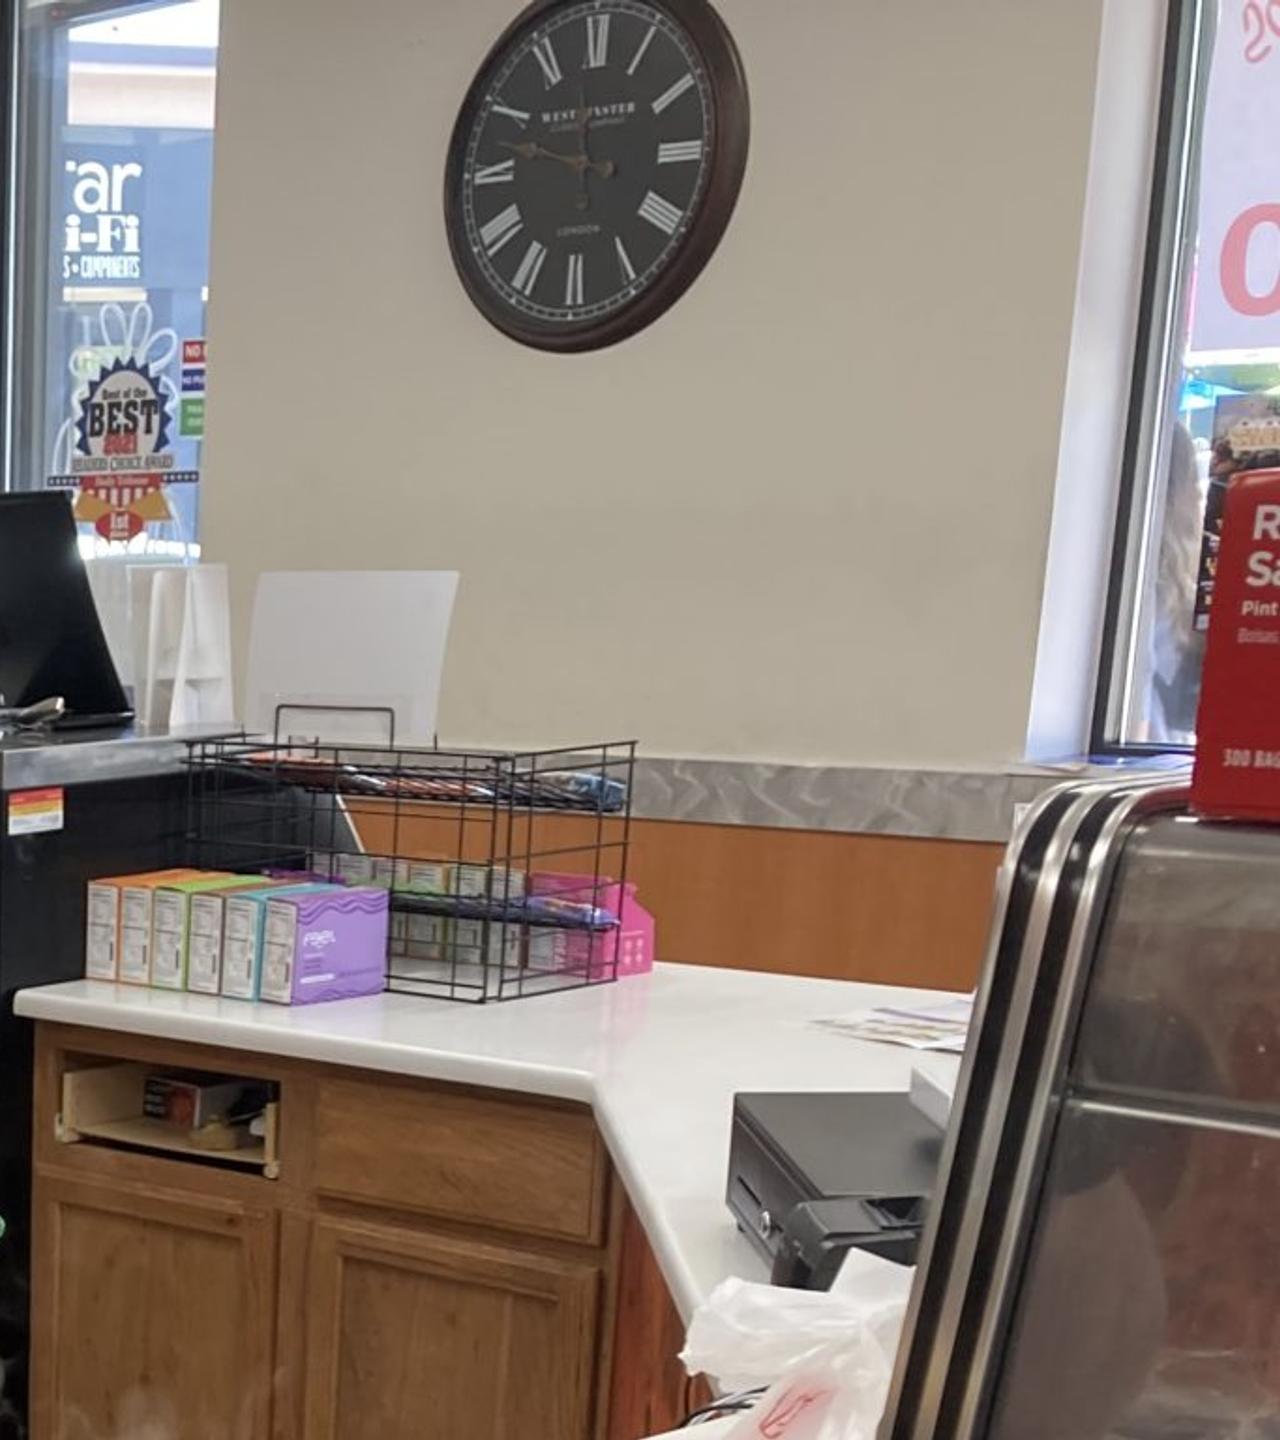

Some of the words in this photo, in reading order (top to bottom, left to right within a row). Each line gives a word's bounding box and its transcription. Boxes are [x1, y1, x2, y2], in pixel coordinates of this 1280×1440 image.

[65, 160, 142, 214] ar
[65, 214, 140, 253] i-Fi
[89, 400, 159, 437] BEST
